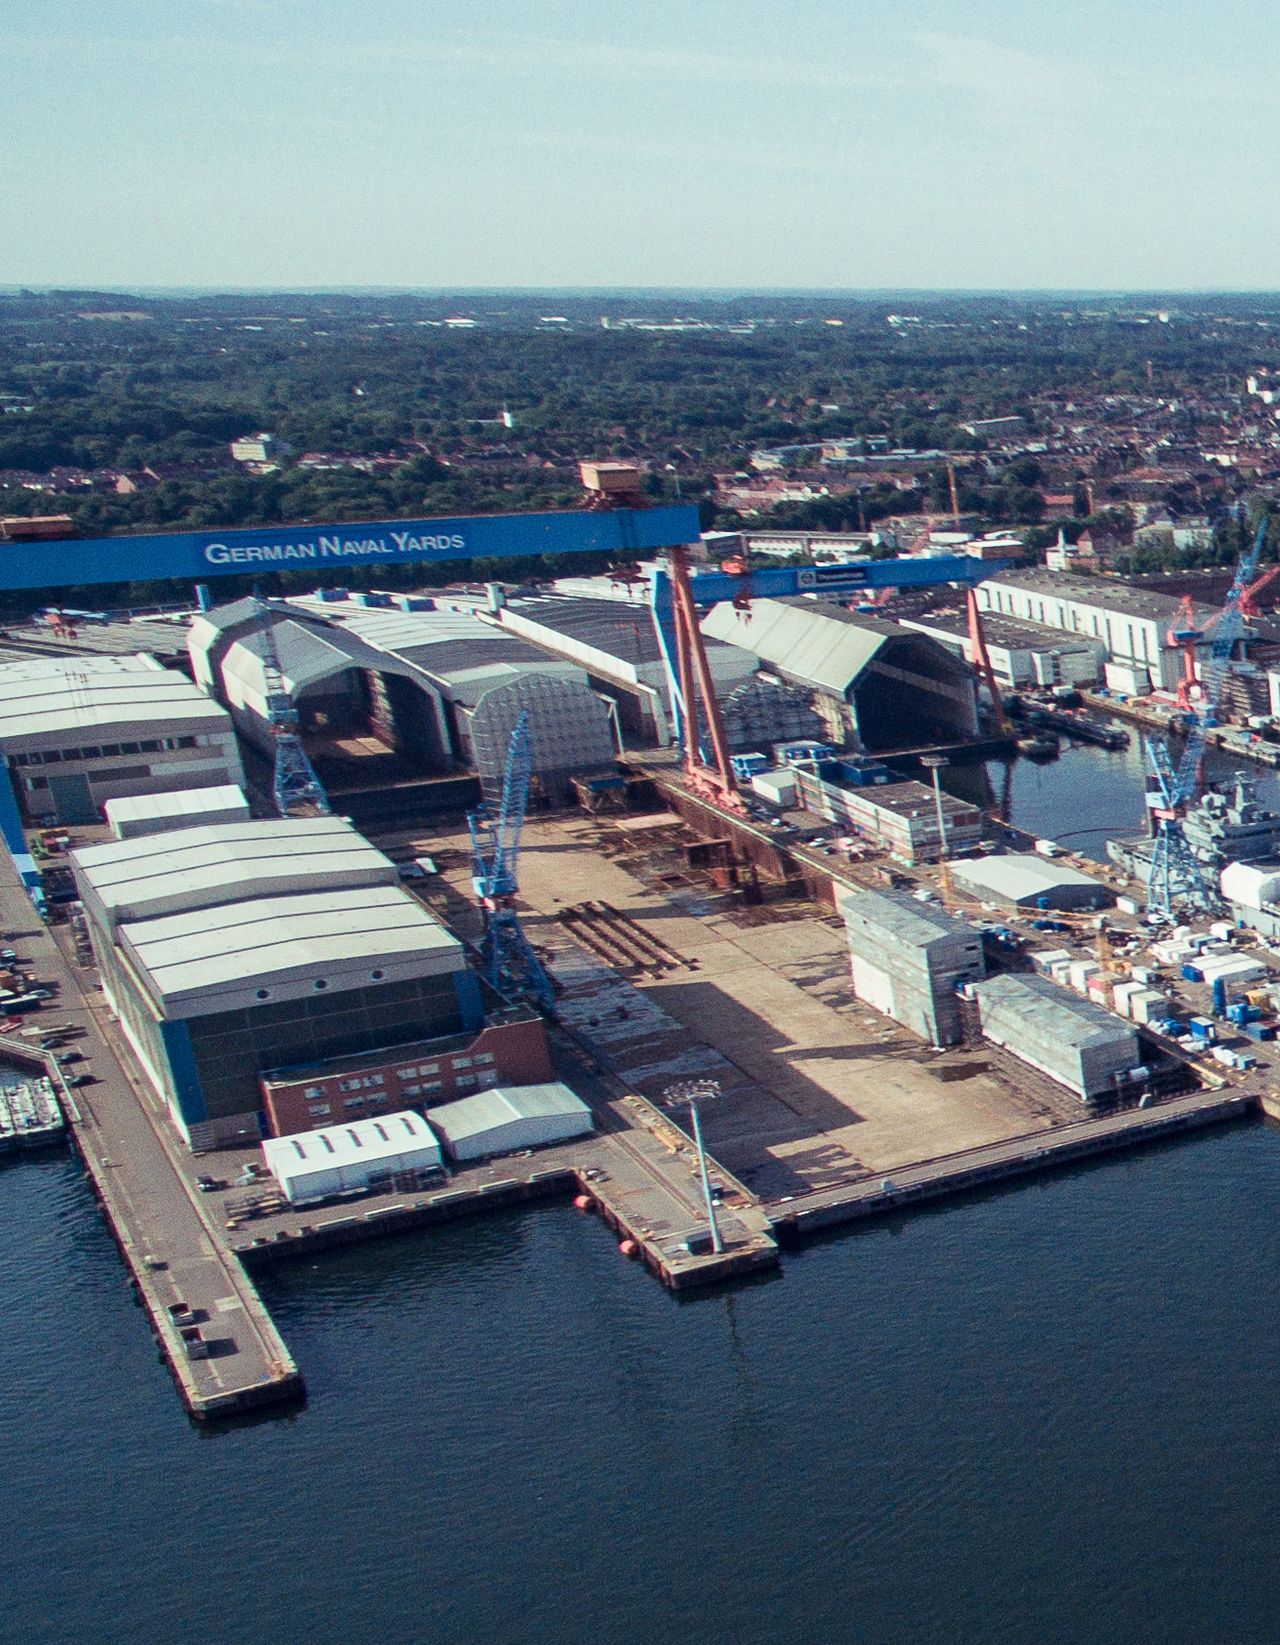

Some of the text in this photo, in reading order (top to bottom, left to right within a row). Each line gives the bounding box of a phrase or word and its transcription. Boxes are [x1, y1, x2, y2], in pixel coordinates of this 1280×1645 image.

[204, 531, 465, 564] GERMAN NAVAL YARDS
